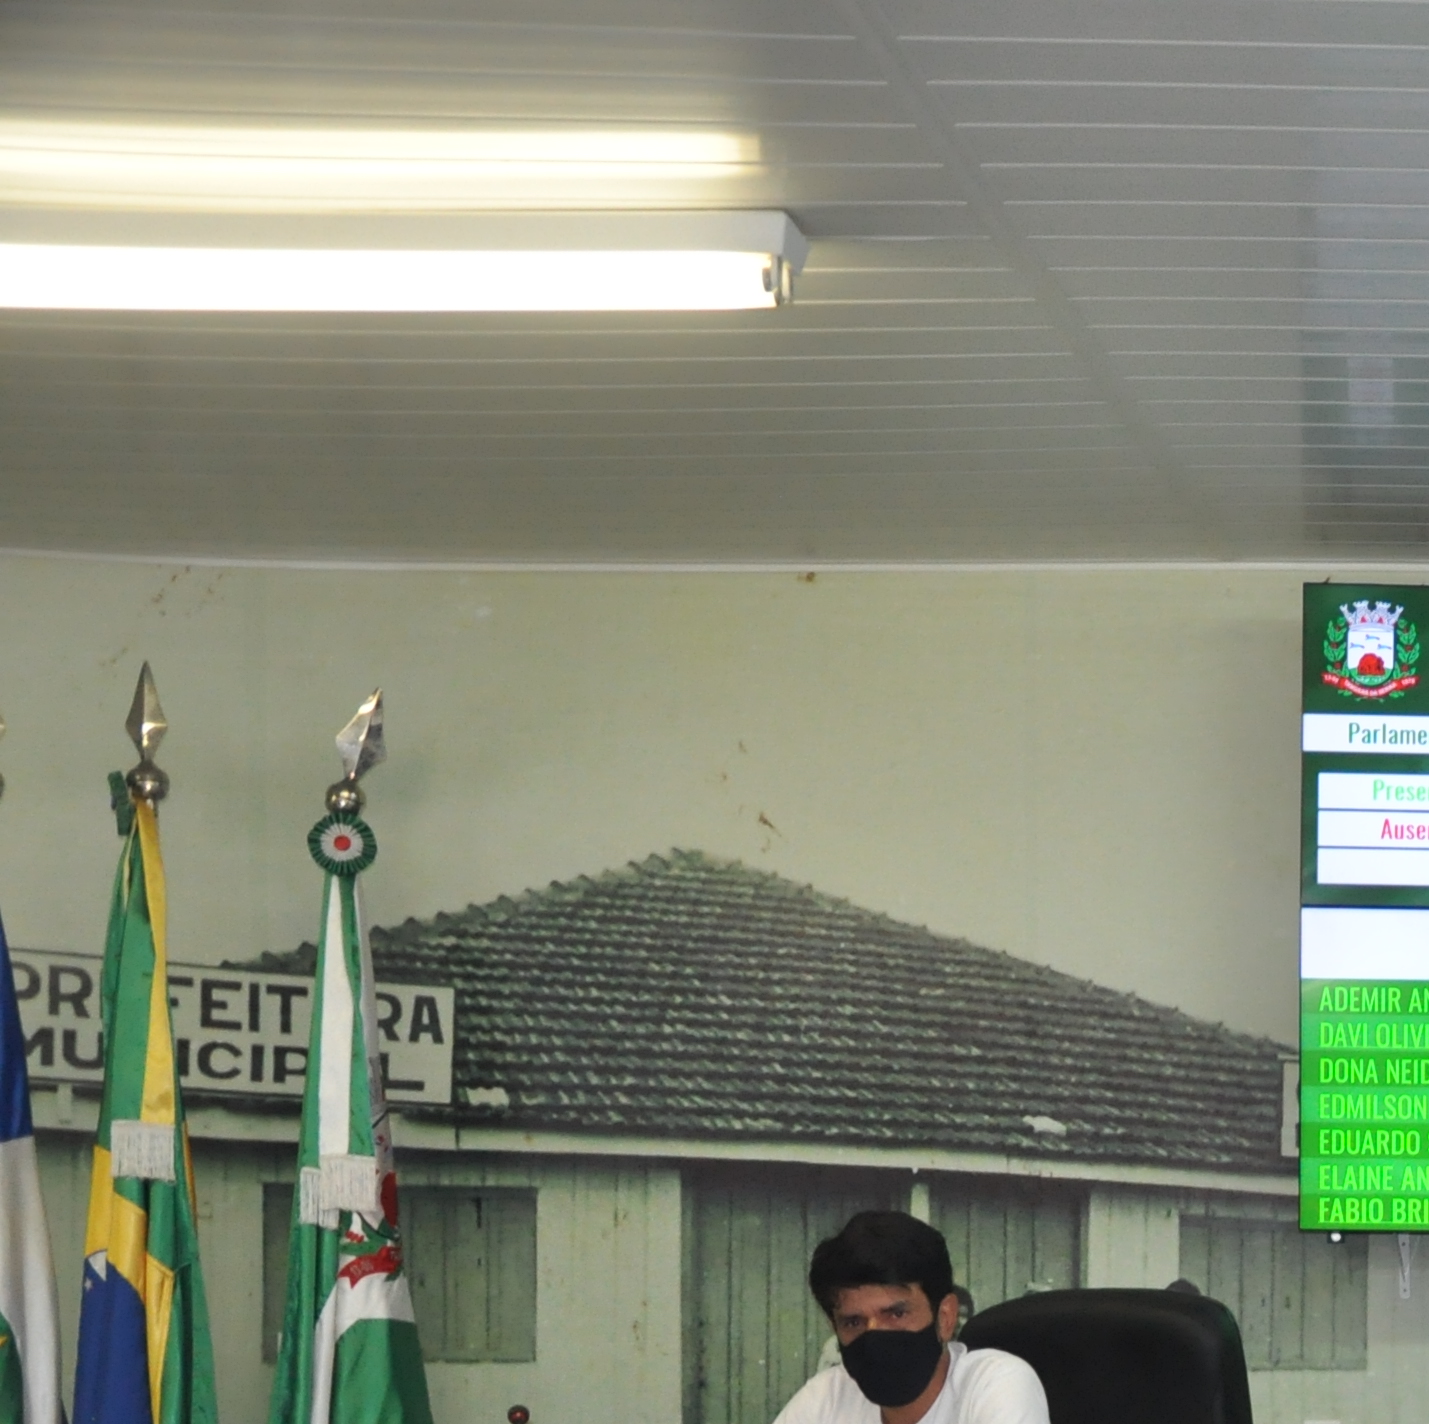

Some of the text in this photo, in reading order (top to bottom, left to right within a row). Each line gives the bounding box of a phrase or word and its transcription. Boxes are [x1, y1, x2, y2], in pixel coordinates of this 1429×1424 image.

[12, 961, 444, 1044] PRFEITRA
[1319, 986, 1402, 1014] ADEMIR
[1319, 1022, 1371, 1049] DAVI
[26, 1026, 425, 1091] MUICIPL
[1319, 1057, 1378, 1085] DONA
[1319, 1093, 1428, 1121] EDMILSON
[1319, 1128, 1421, 1156] EDUARDO
[1319, 1164, 1393, 1191] ELAINE
[1318, 1197, 1383, 1225] FABIO
